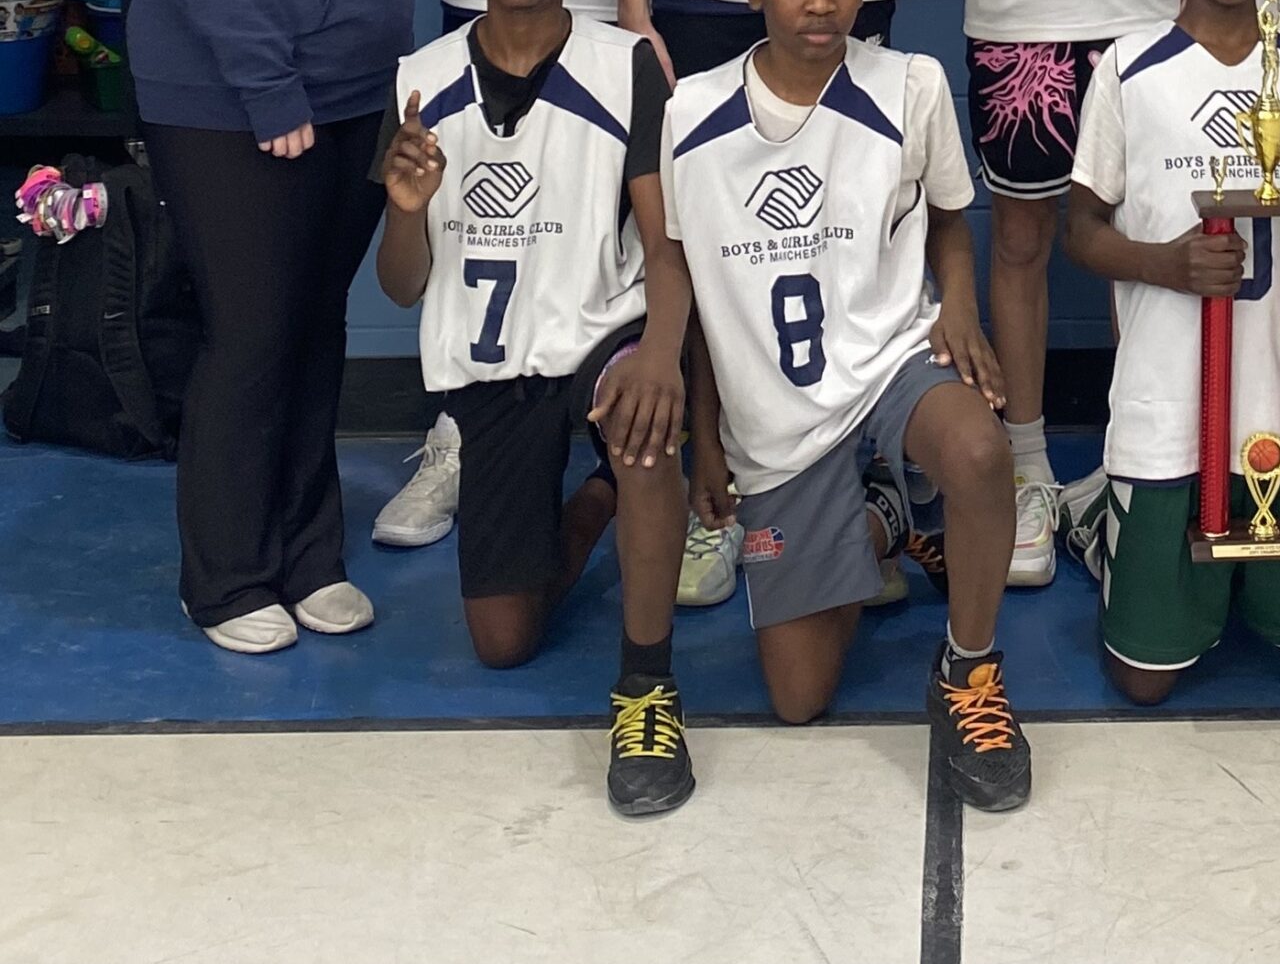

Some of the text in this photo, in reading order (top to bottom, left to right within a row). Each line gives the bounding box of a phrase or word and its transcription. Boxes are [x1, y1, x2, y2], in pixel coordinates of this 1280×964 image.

[1165, 156, 1204, 170] BOYS
[1191, 169, 1205, 179] OF
[466, 224, 478, 234] &
[482, 225, 525, 236] GIRLS
[529, 222, 563, 234] CLUB
[467, 235, 537, 247] MANCHESTER
[721, 241, 762, 257] BOYS
[767, 239, 779, 251] &
[750, 254, 765, 265] OF
[463, 258, 517, 364] 7
[771, 272, 826, 388] 8
